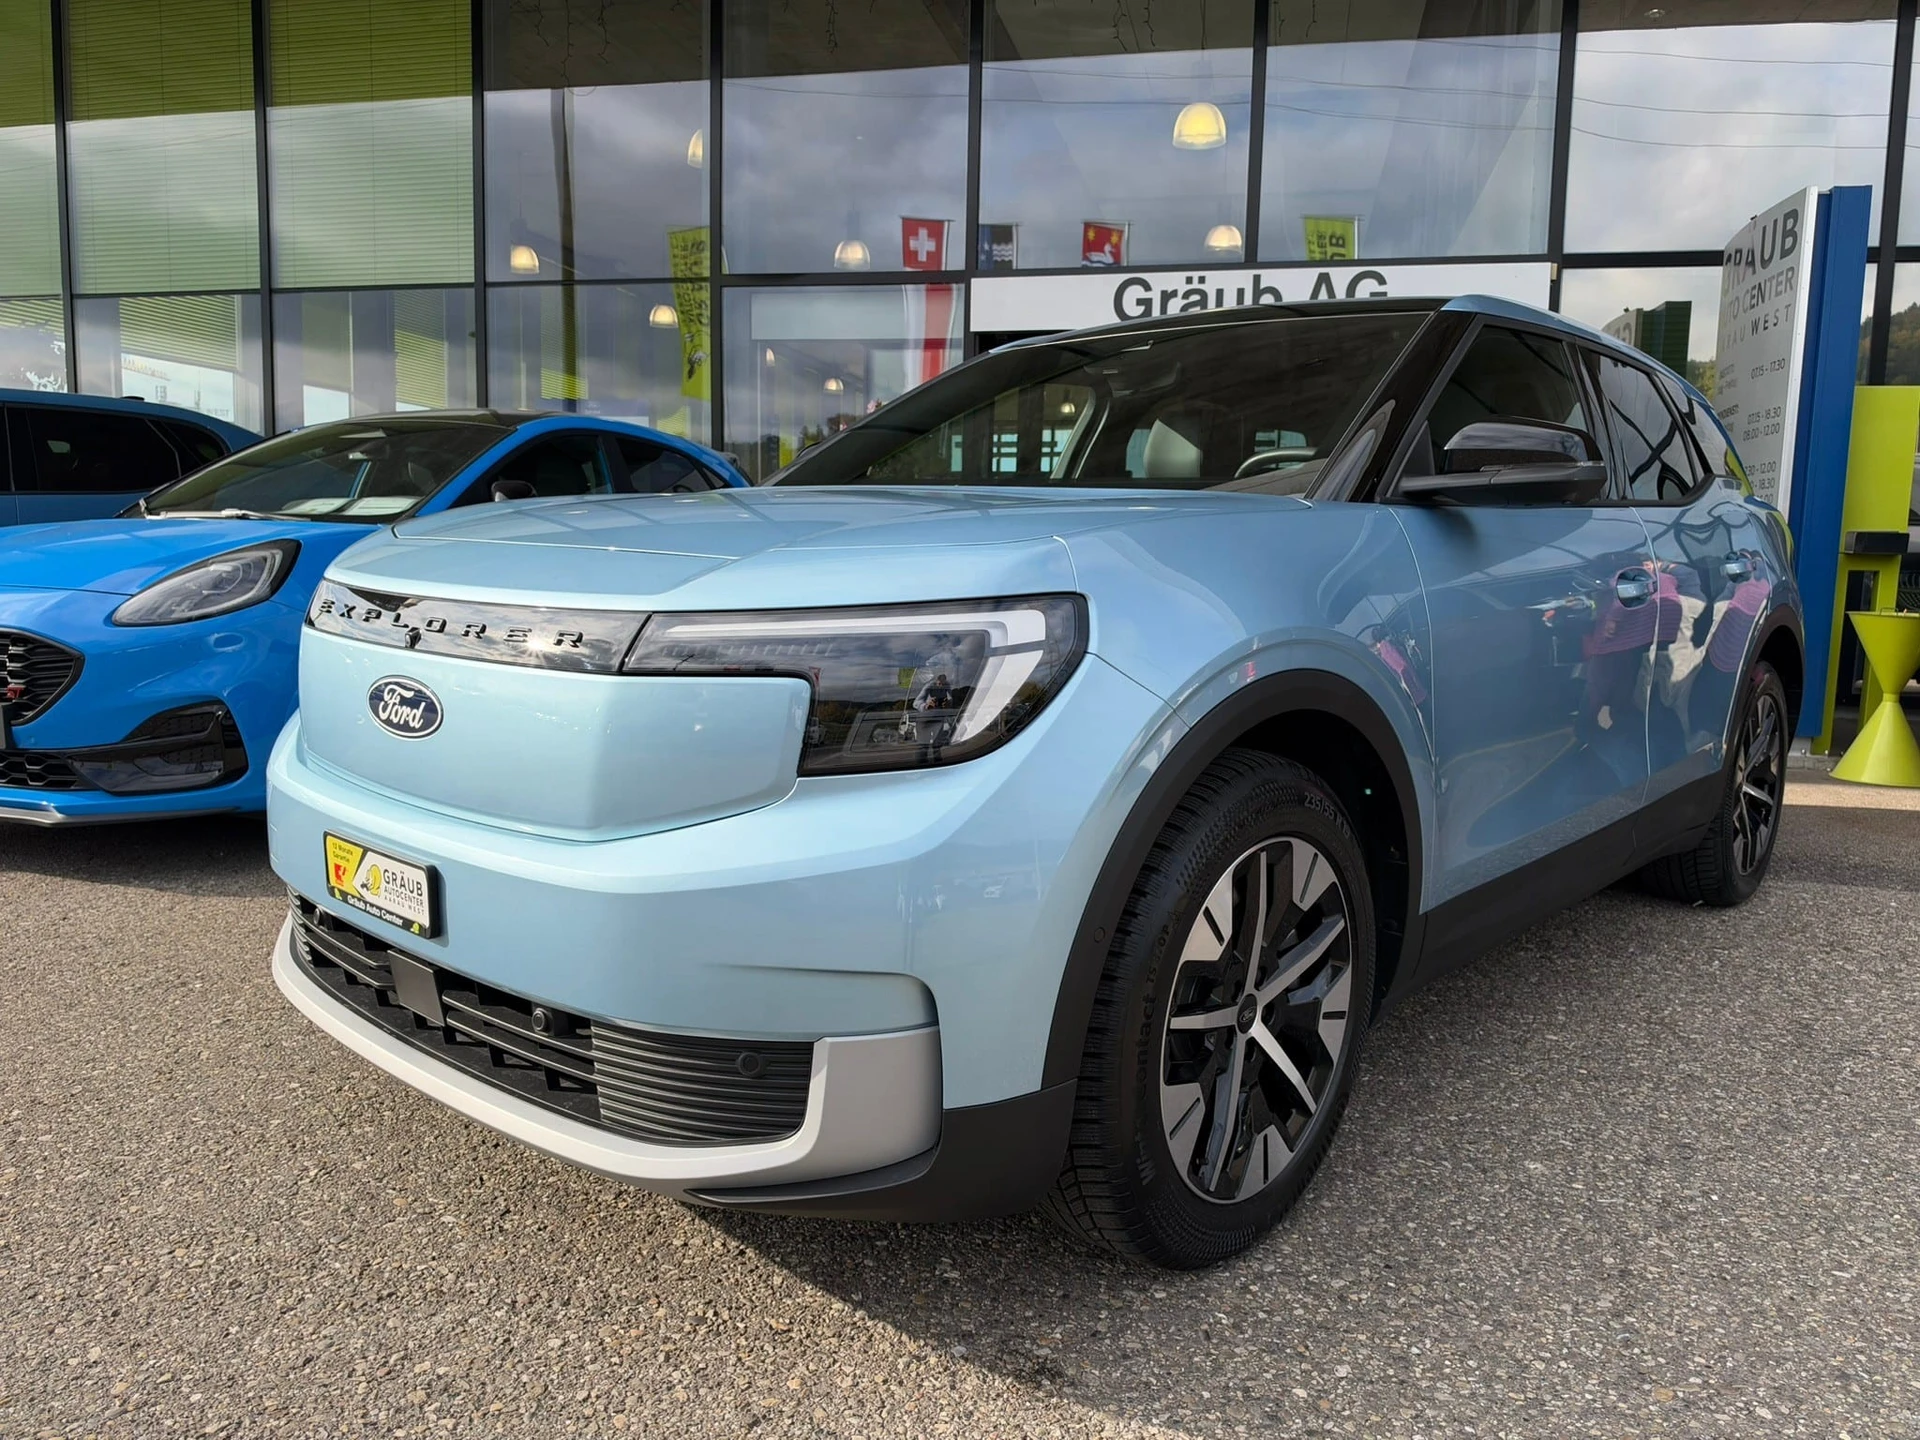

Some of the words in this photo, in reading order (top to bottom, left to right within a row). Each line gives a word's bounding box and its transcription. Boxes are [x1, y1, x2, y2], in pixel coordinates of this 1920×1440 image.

[1113, 273, 1284, 322] Gräub
[1309, 269, 1389, 301] AG
[1750, 303, 1792, 337] WEST
[318, 598, 584, 649] EXPLORER
[378, 683, 426, 729] Ford
[382, 868, 424, 897] GRÄUB
